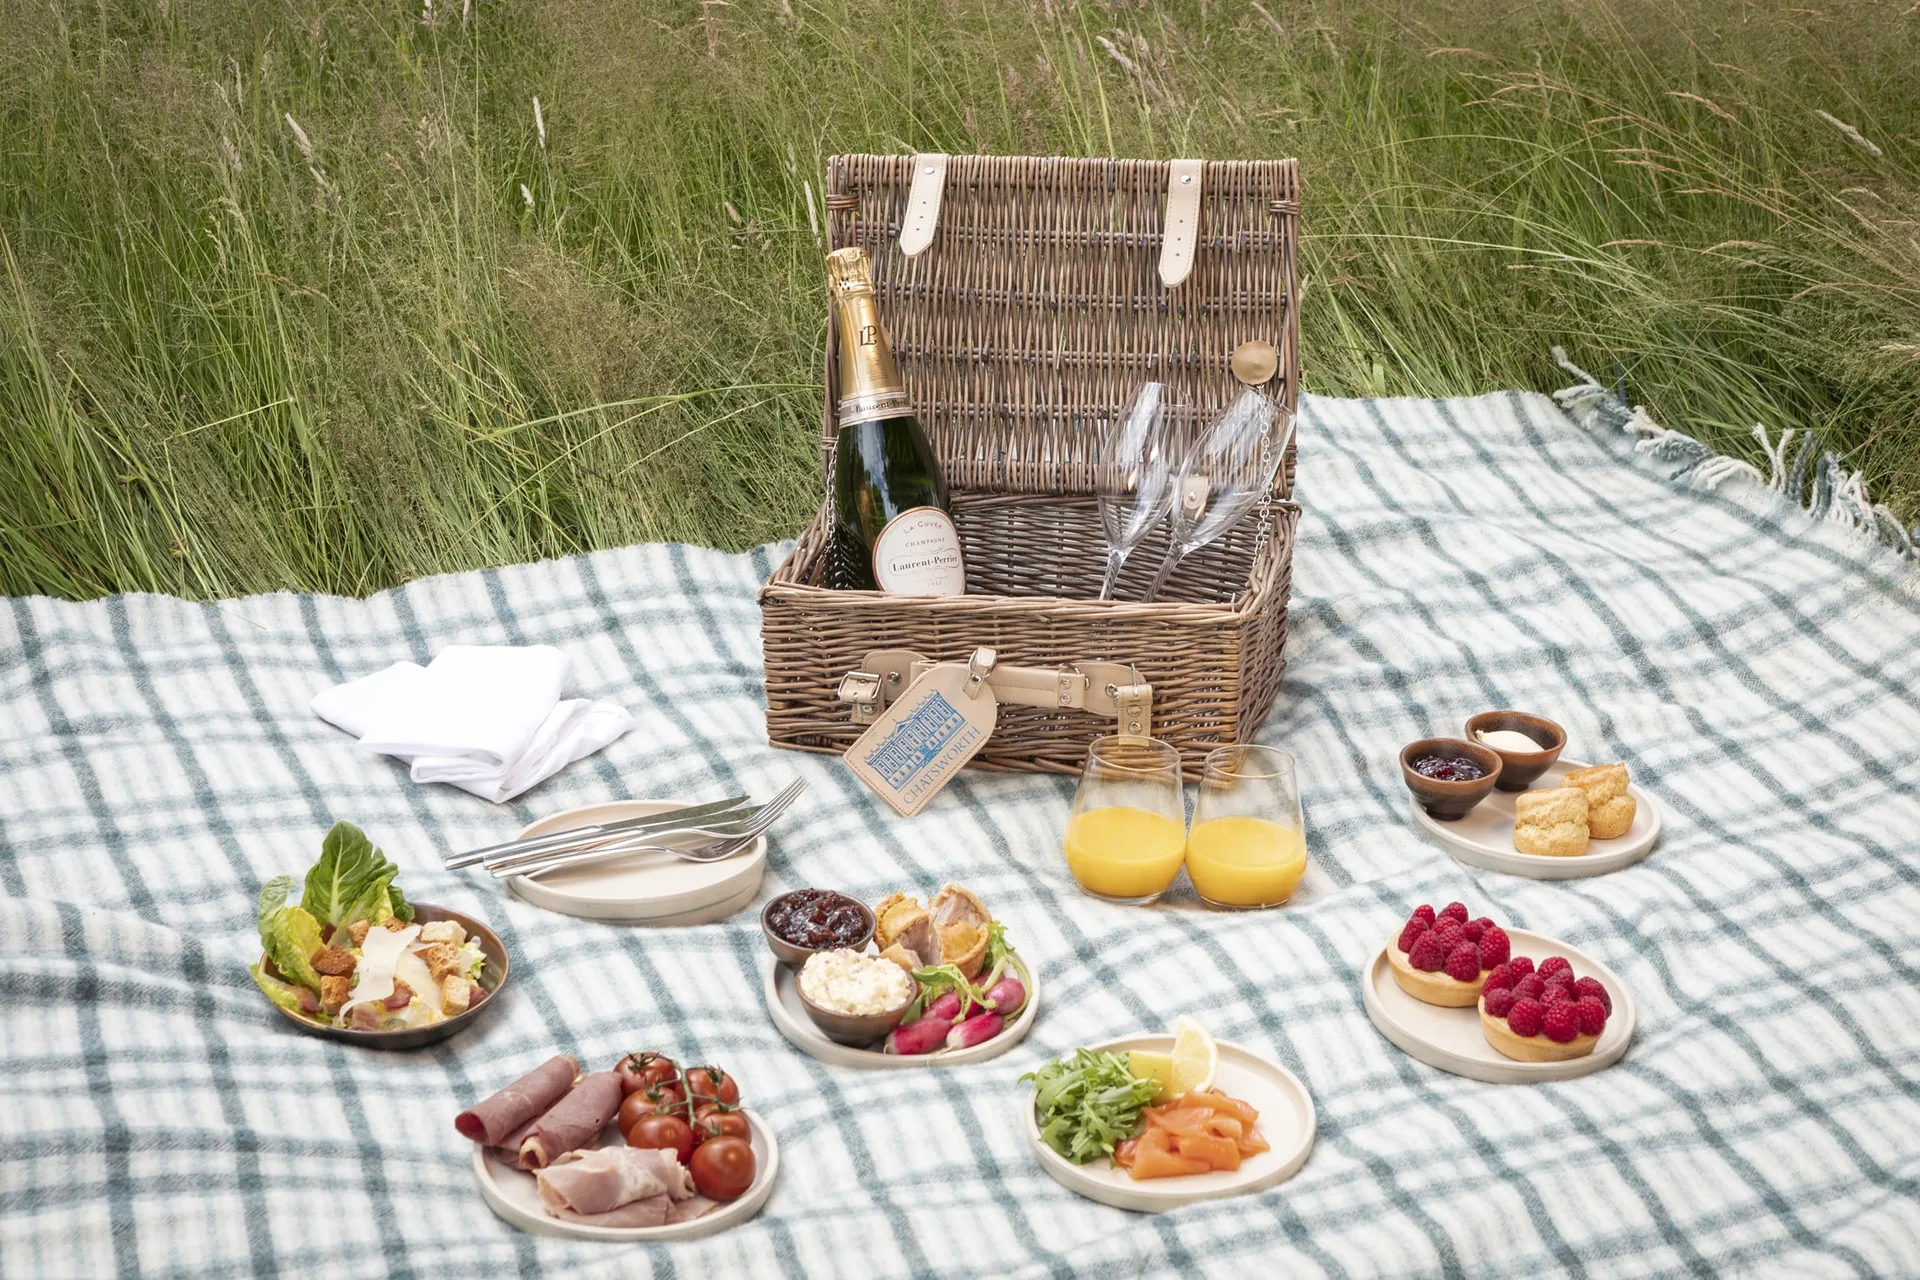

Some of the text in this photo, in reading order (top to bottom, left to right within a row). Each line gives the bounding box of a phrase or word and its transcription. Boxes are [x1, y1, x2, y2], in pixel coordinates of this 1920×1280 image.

[905, 537, 945, 547] CHAMPAGNE
[892, 554, 958, 572] Laurent-Perrier
[903, 726, 981, 804] CHATSWORTH
